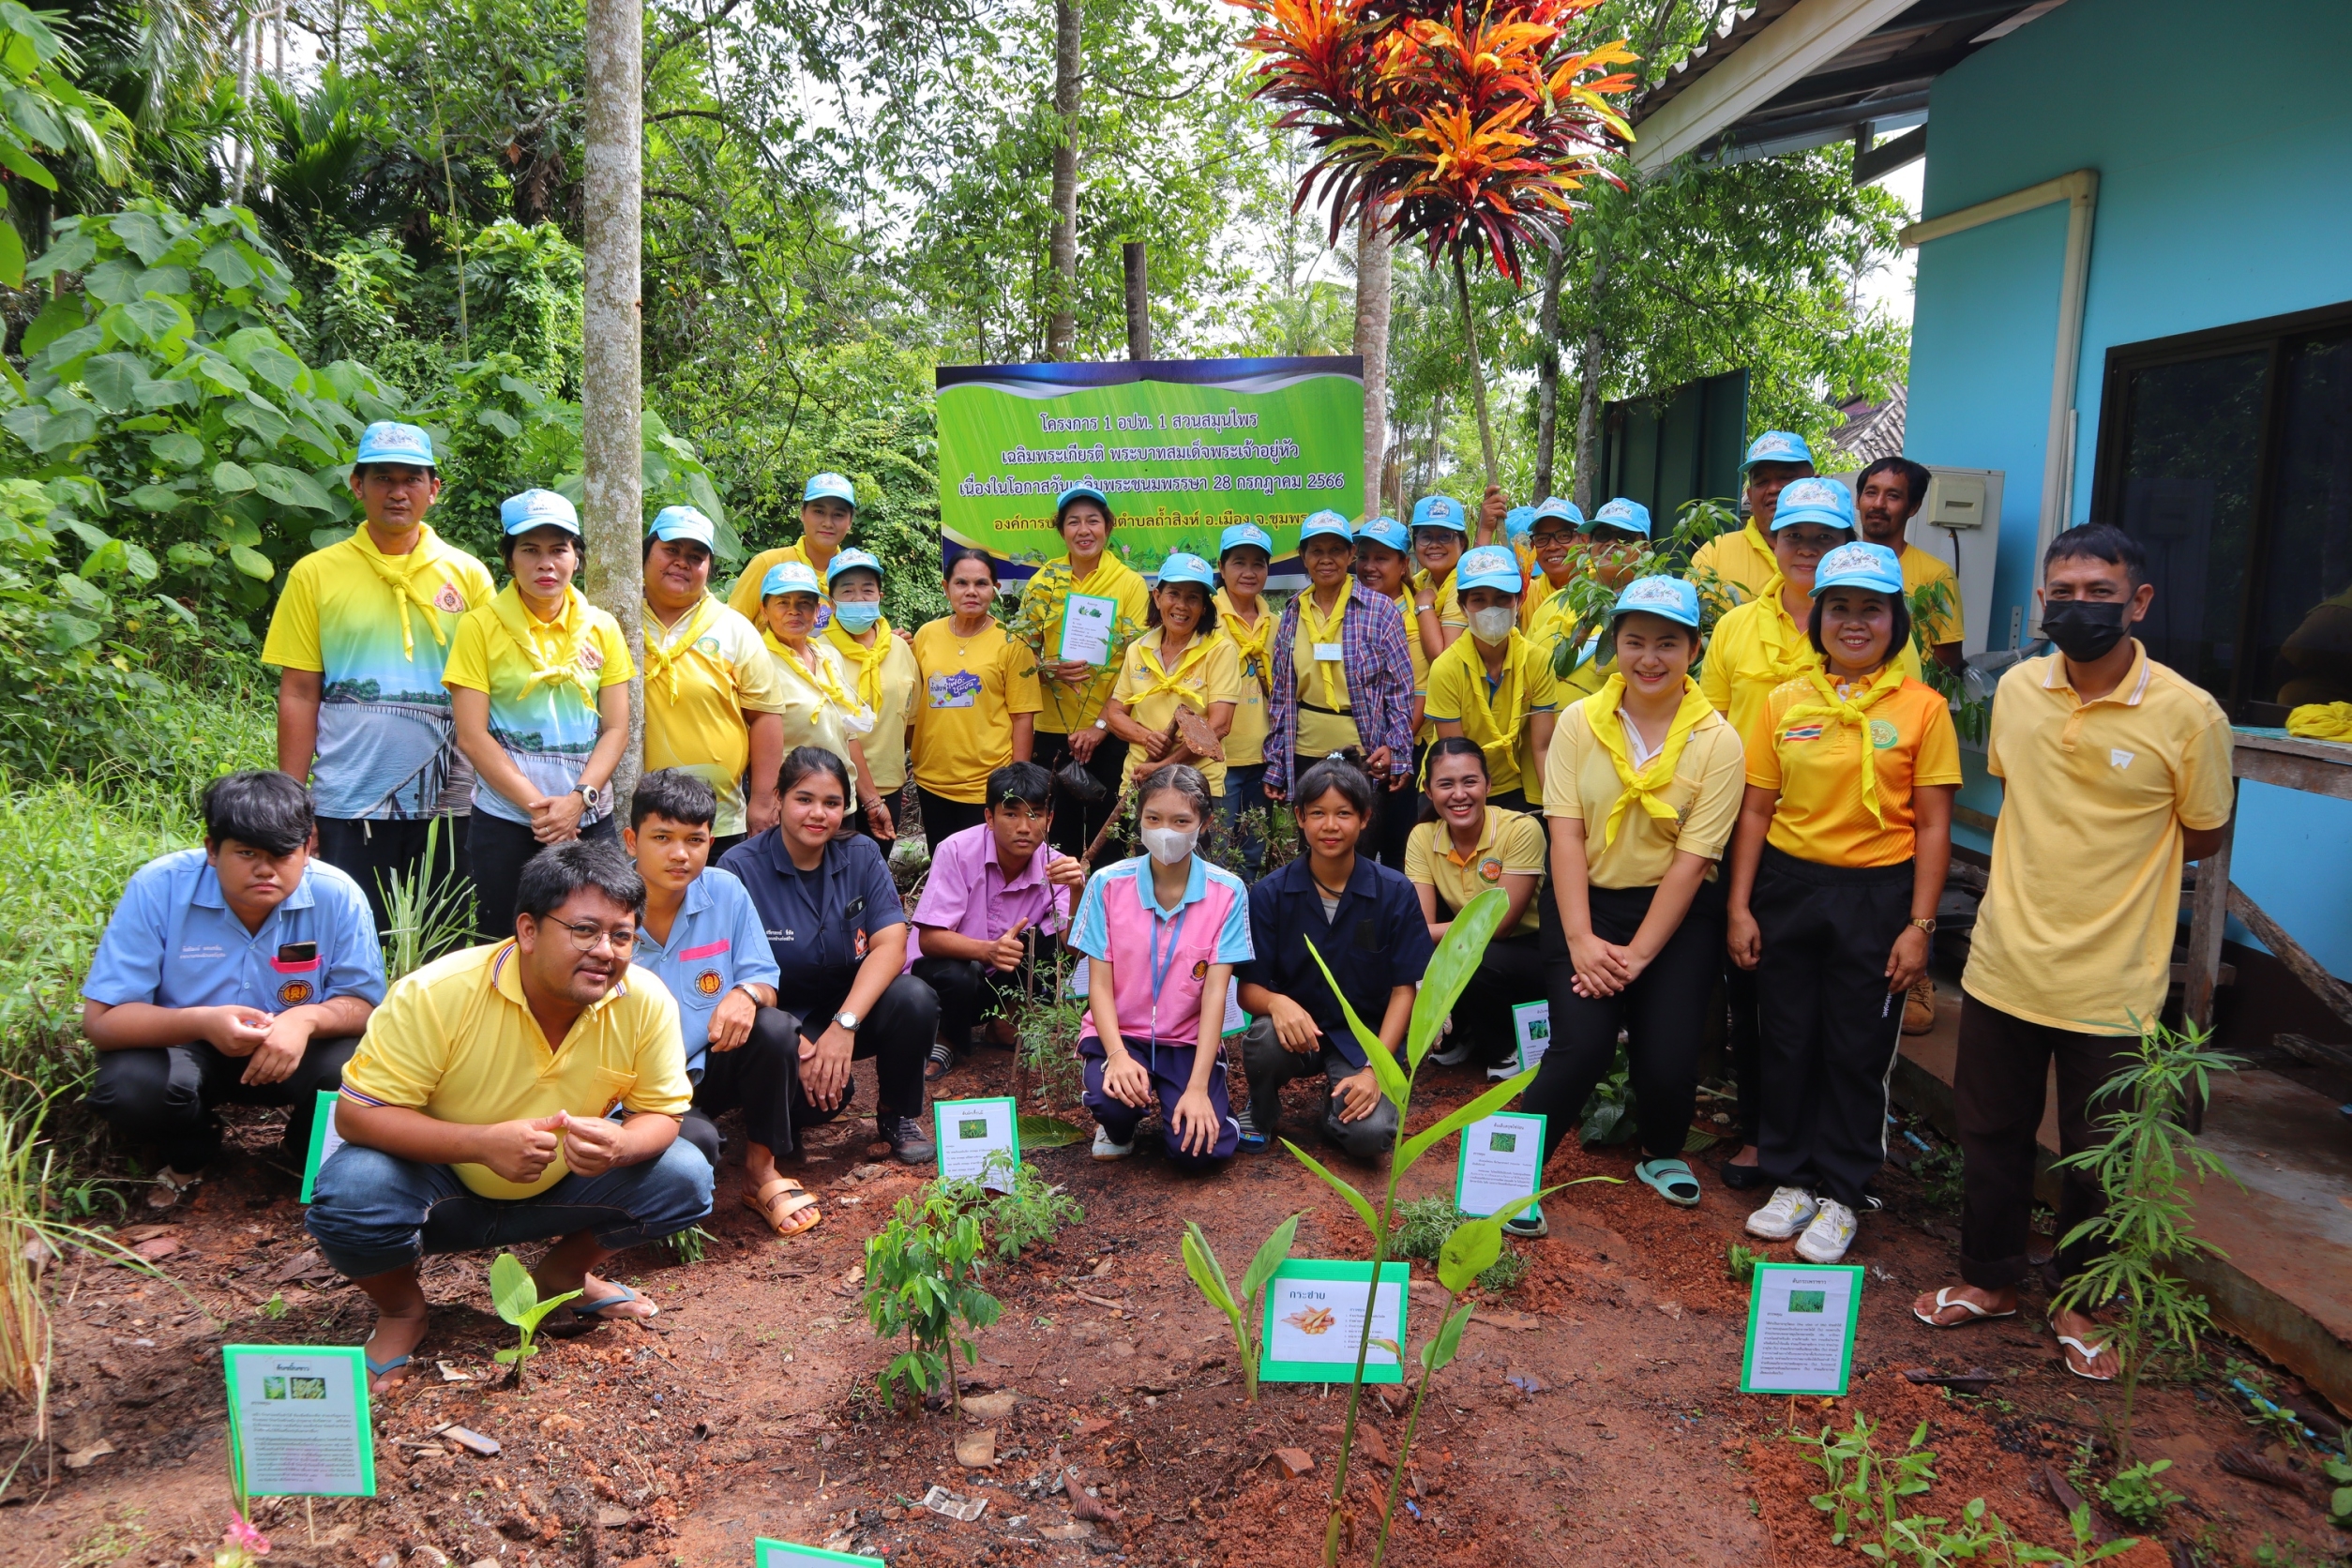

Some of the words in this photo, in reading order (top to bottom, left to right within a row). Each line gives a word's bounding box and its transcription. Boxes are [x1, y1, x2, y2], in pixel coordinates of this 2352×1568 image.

[1040, 412, 1098, 432] โครงการ
[1104, 415, 1111, 430] 1
[1117, 413, 1153, 430] อปท.
[1158, 414, 1167, 430] 1
[1171, 408, 1259, 433] สวนสมุนไพร
[1002, 443, 1105, 465] เฉลิมพระเกียรติ
[1109, 438, 1300, 465] พระบาทสมเด็จพระเจ้าอยู่หัว
[959, 473, 1208, 497] เนื่องในโอกาสวันเลิมพระชนมพรรษา
[1213, 475, 1231, 490] 28
[1237, 475, 1302, 495] กรกฎาคม
[1307, 473, 1345, 490] 2566
[1205, 509, 1250, 527] อ.เมือง
[1289, 1289, 1326, 1301] กระชาย
